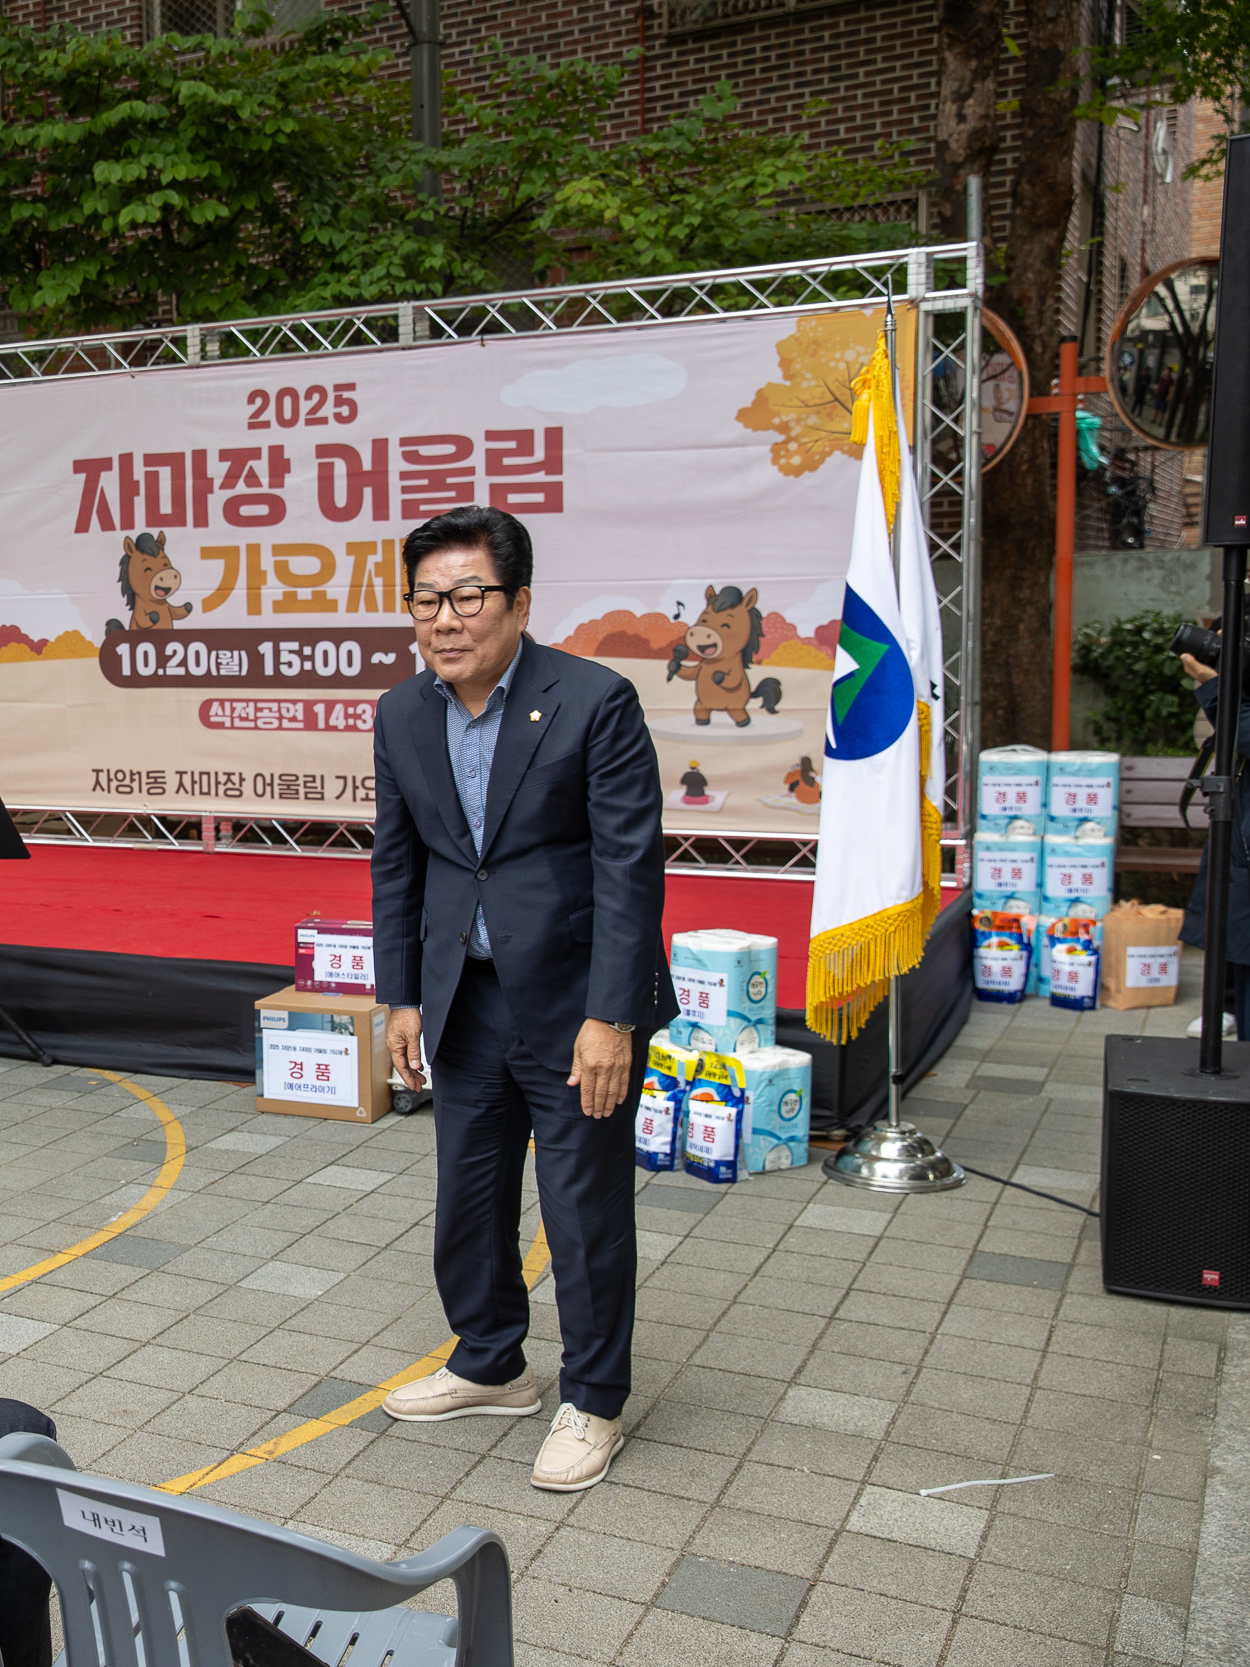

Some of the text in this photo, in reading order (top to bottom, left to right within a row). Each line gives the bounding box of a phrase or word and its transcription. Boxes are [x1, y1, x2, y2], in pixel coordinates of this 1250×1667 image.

[247, 382, 358, 430] 2025
[72, 426, 564, 534] 자마장 어울림
[200, 539, 408, 617] 가요제
[115, 641, 249, 677] 10.20(월)
[257, 640, 362, 677] 15:00
[209, 701, 375, 731] 식전공연 14:3
[91, 768, 167, 796] 자양1동
[175, 770, 246, 799] 자마장
[253, 772, 325, 801] 어울림
[262, 1015, 286, 1023] PHILIPS
[283, 1082, 337, 1095] [에어프라이기]
[80, 1509, 148, 1543] 내빈석
